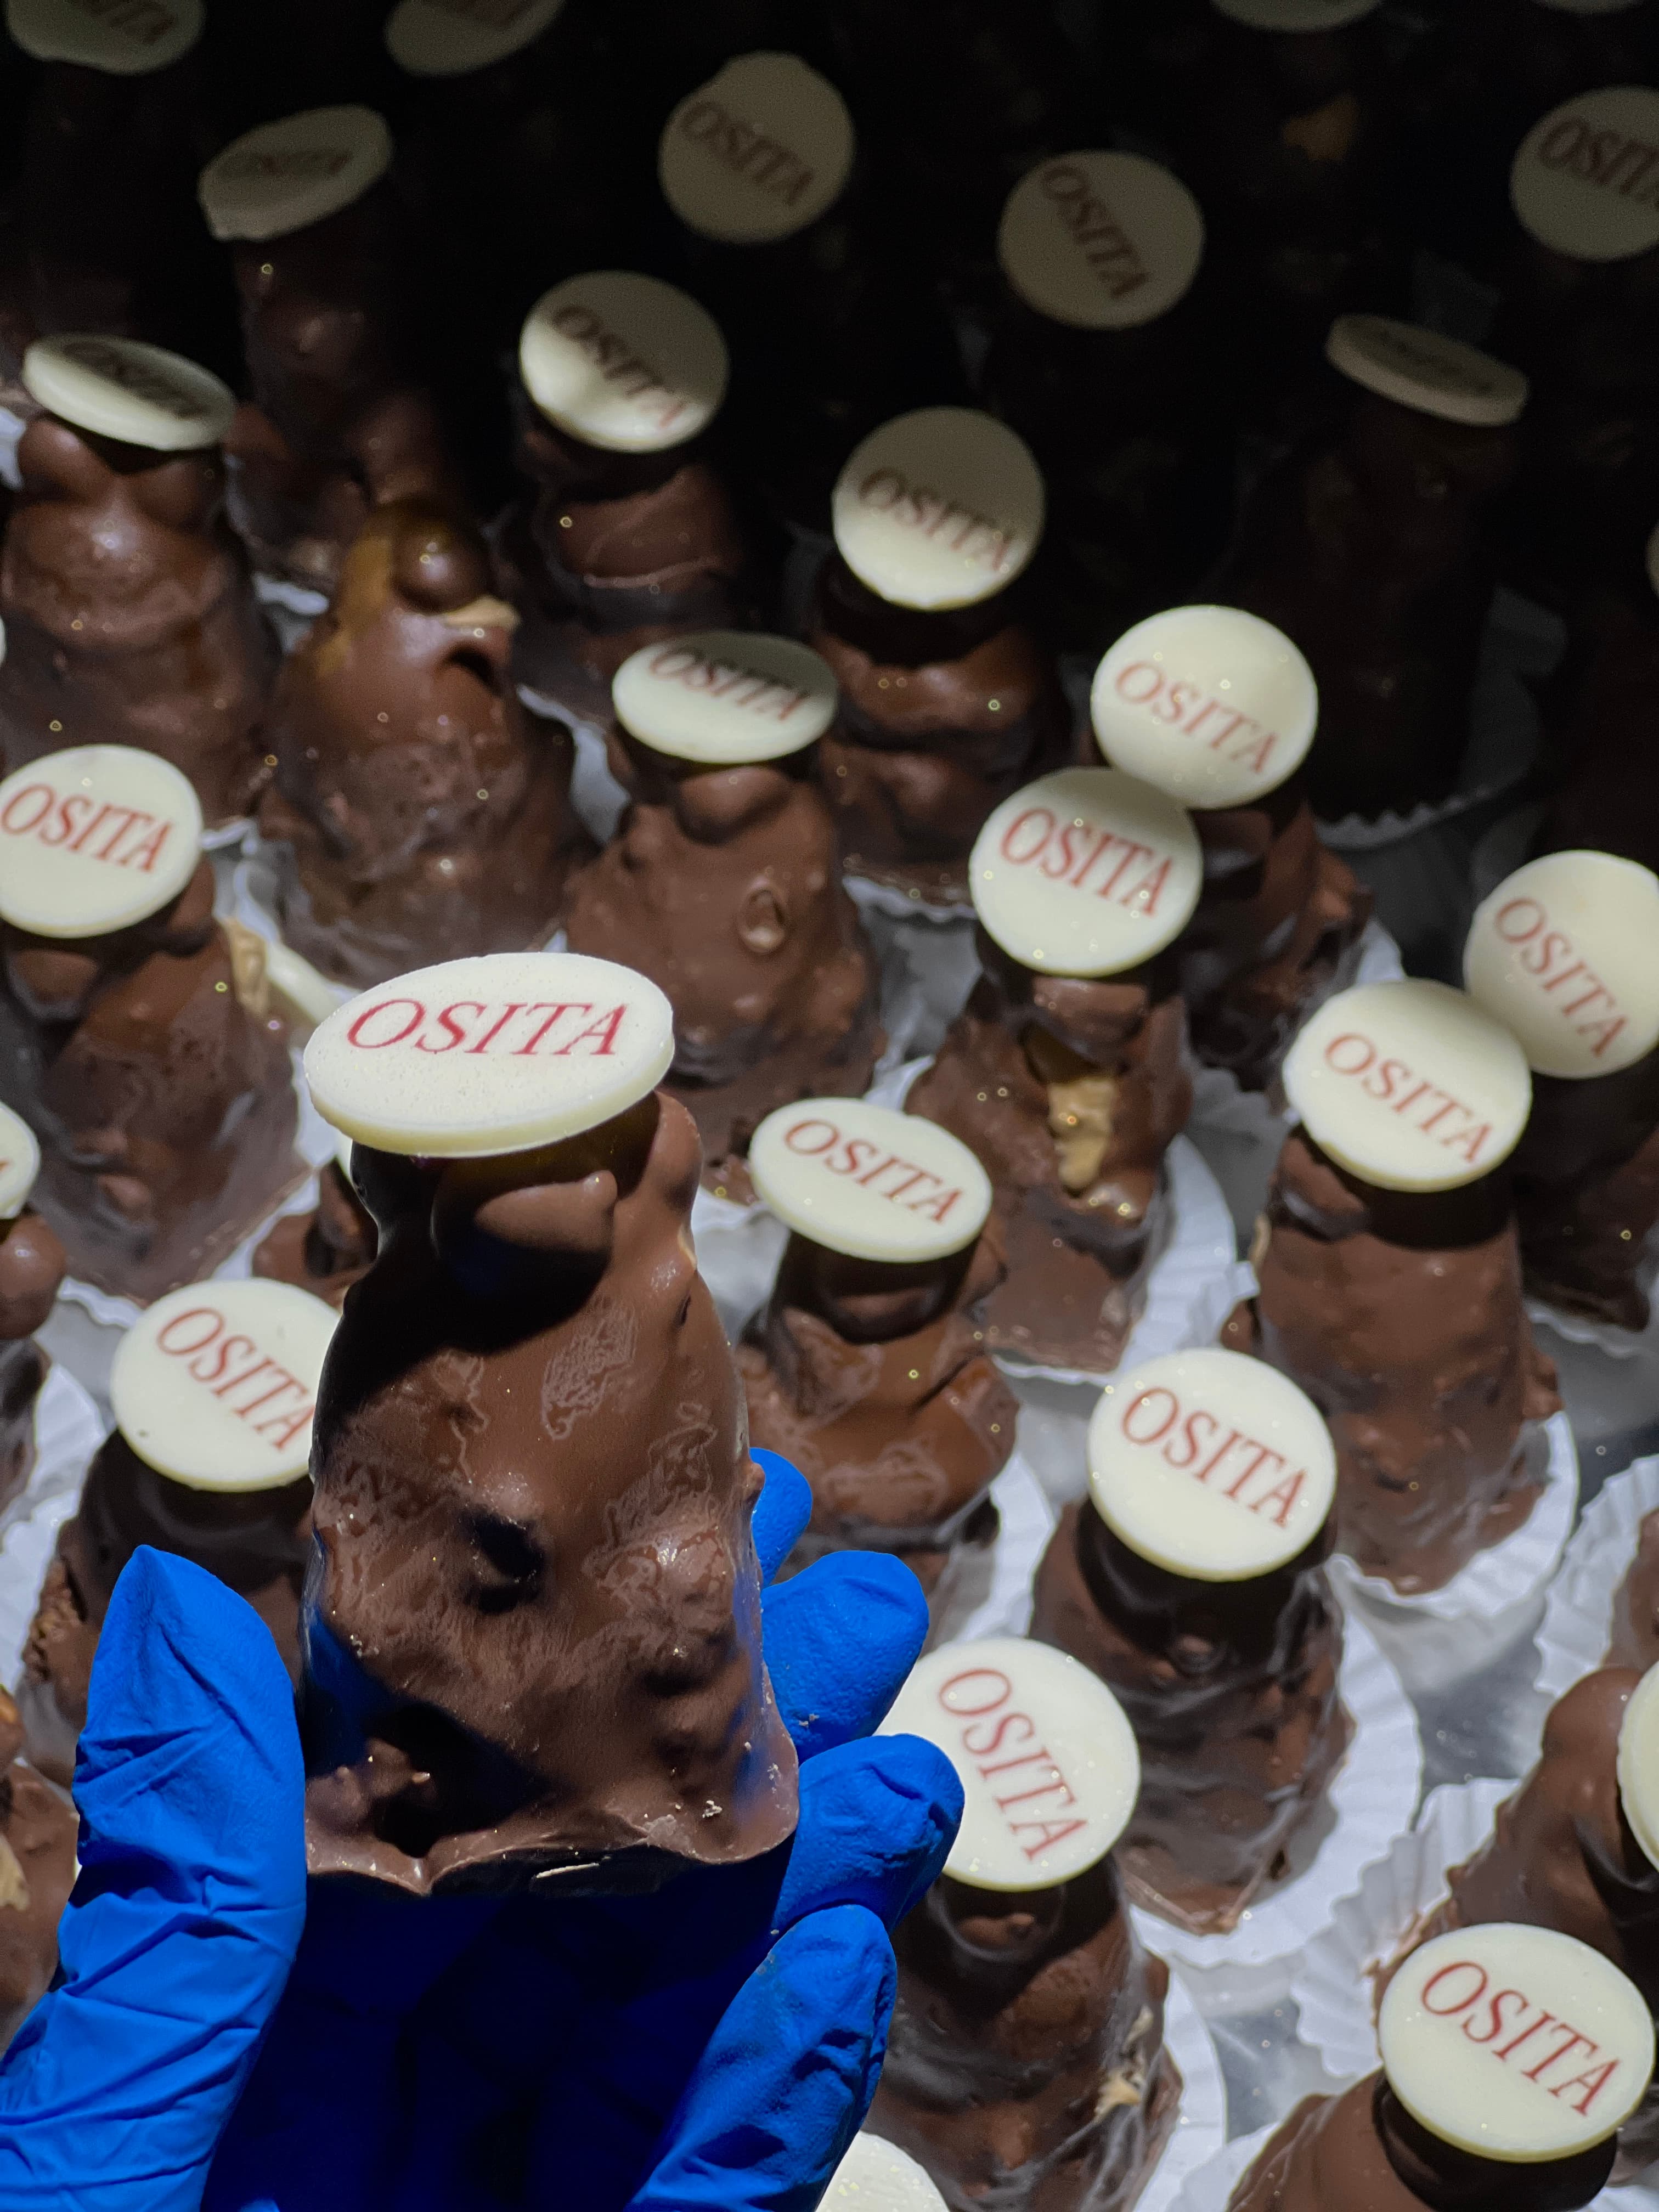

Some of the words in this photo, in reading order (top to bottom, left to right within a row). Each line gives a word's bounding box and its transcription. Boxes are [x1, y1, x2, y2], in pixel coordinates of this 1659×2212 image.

[1541, 117, 1659, 207] OSIT
[860, 467, 1014, 571] OSITA
[649, 644, 811, 721] OSITA
[1114, 662, 1277, 774] OSITA
[0, 783, 173, 871] OSITA
[1000, 808, 1173, 916] OSITA
[347, 998, 625, 1056] OSITA
[1496, 898, 1628, 1057] OSITA
[1324, 1032, 1492, 1162] OSITA
[784, 1119, 964, 1223] OSITA
[156, 1307, 316, 1450] OSITA
[1121, 1386, 1307, 1526] OSITA
[938, 1667, 1088, 1859] OSITA
[1421, 1962, 1621, 2117] OSITA
